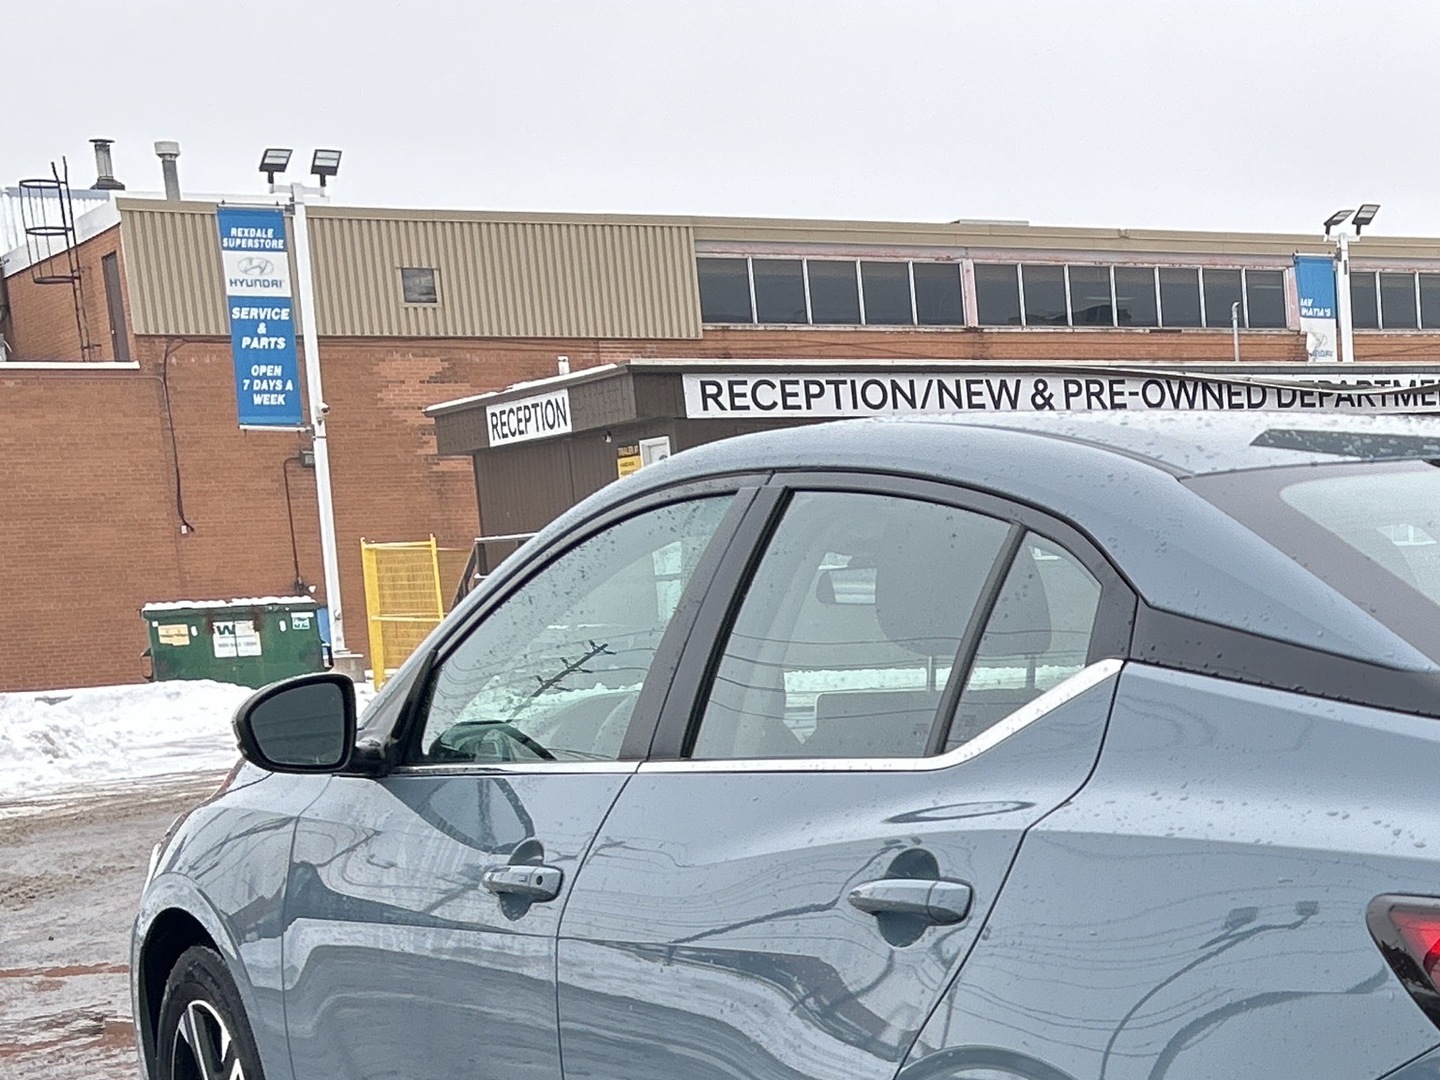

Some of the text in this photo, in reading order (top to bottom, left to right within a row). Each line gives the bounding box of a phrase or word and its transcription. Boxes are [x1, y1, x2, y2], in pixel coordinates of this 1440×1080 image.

[230, 227, 274, 238] REXDALE
[222, 237, 284, 249] SUPERSTORE
[229, 278, 283, 288] HYUNDAI
[231, 306, 290, 320] SERVICE
[257, 322, 267, 334] &
[241, 336, 286, 349] PARTS
[250, 364, 282, 377] OPEN
[243, 379, 293, 391] 7 DAYS A
[252, 393, 286, 405] WEEK
[700, 378, 1021, 412] RECEPTION/NEW
[1030, 377, 1055, 411] &
[1063, 378, 1268, 410] PRE-OWNED
[489, 396, 568, 442] RECEPTION
